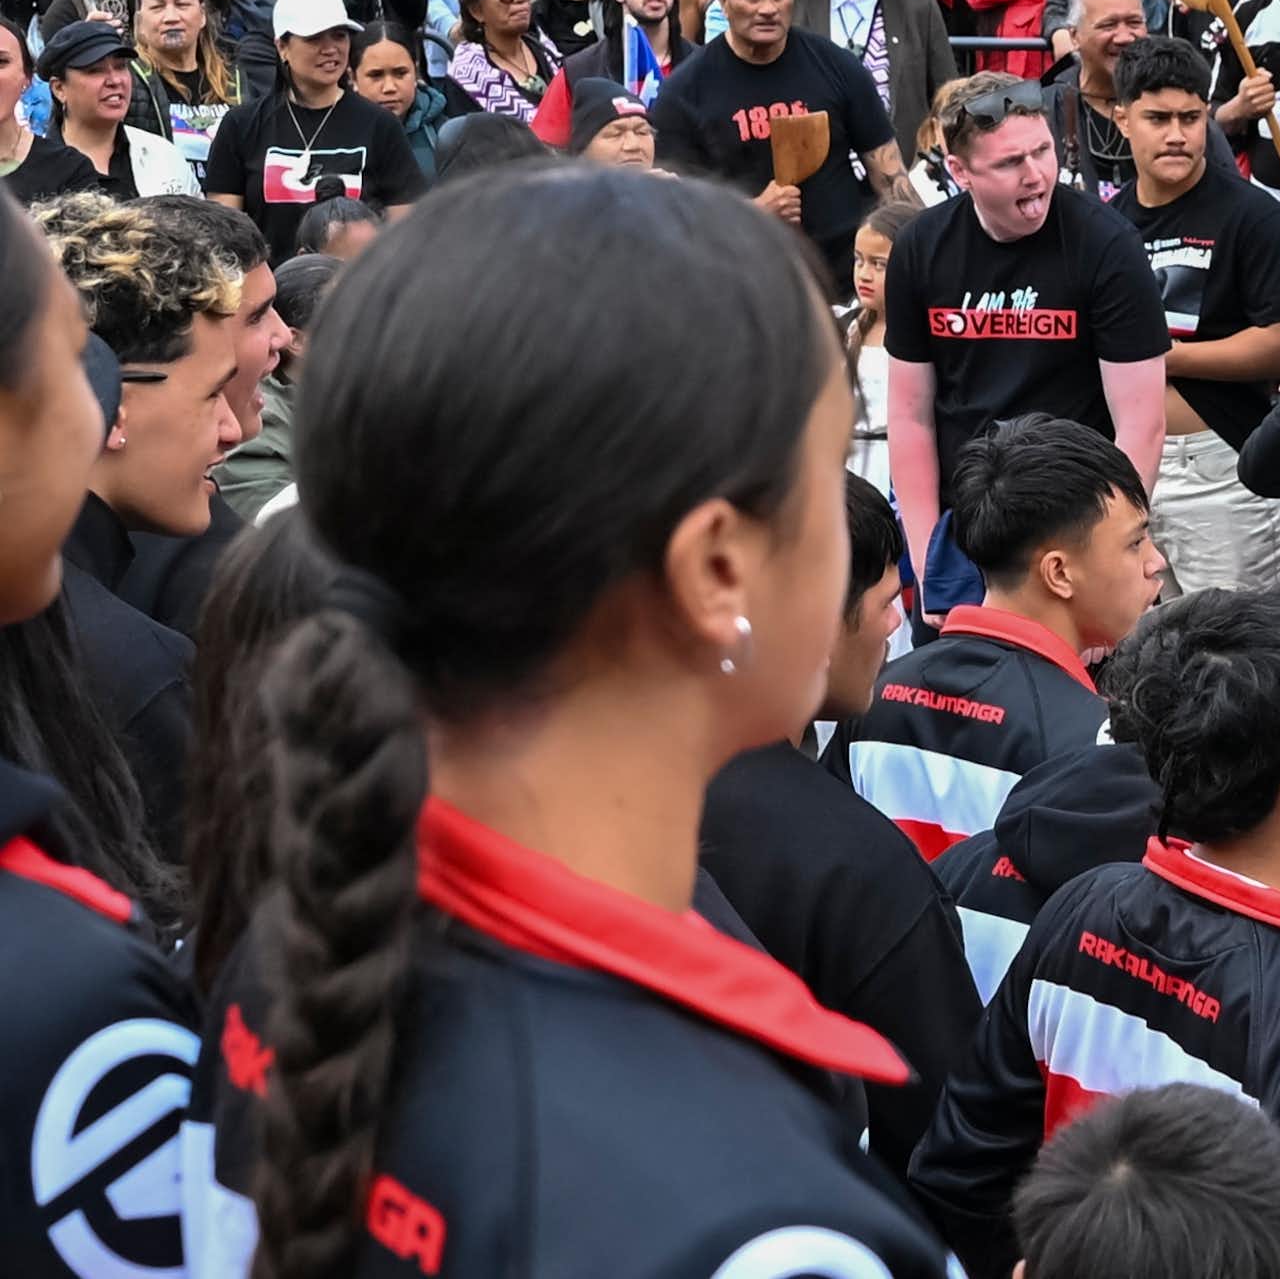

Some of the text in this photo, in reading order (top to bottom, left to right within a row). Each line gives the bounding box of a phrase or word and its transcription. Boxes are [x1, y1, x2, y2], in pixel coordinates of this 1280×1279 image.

[961, 291, 972, 314] I
[975, 291, 1005, 314] AM
[933, 312, 1072, 336] SOVEREIGN
[881, 683, 1006, 725] RAKAUMANGA
